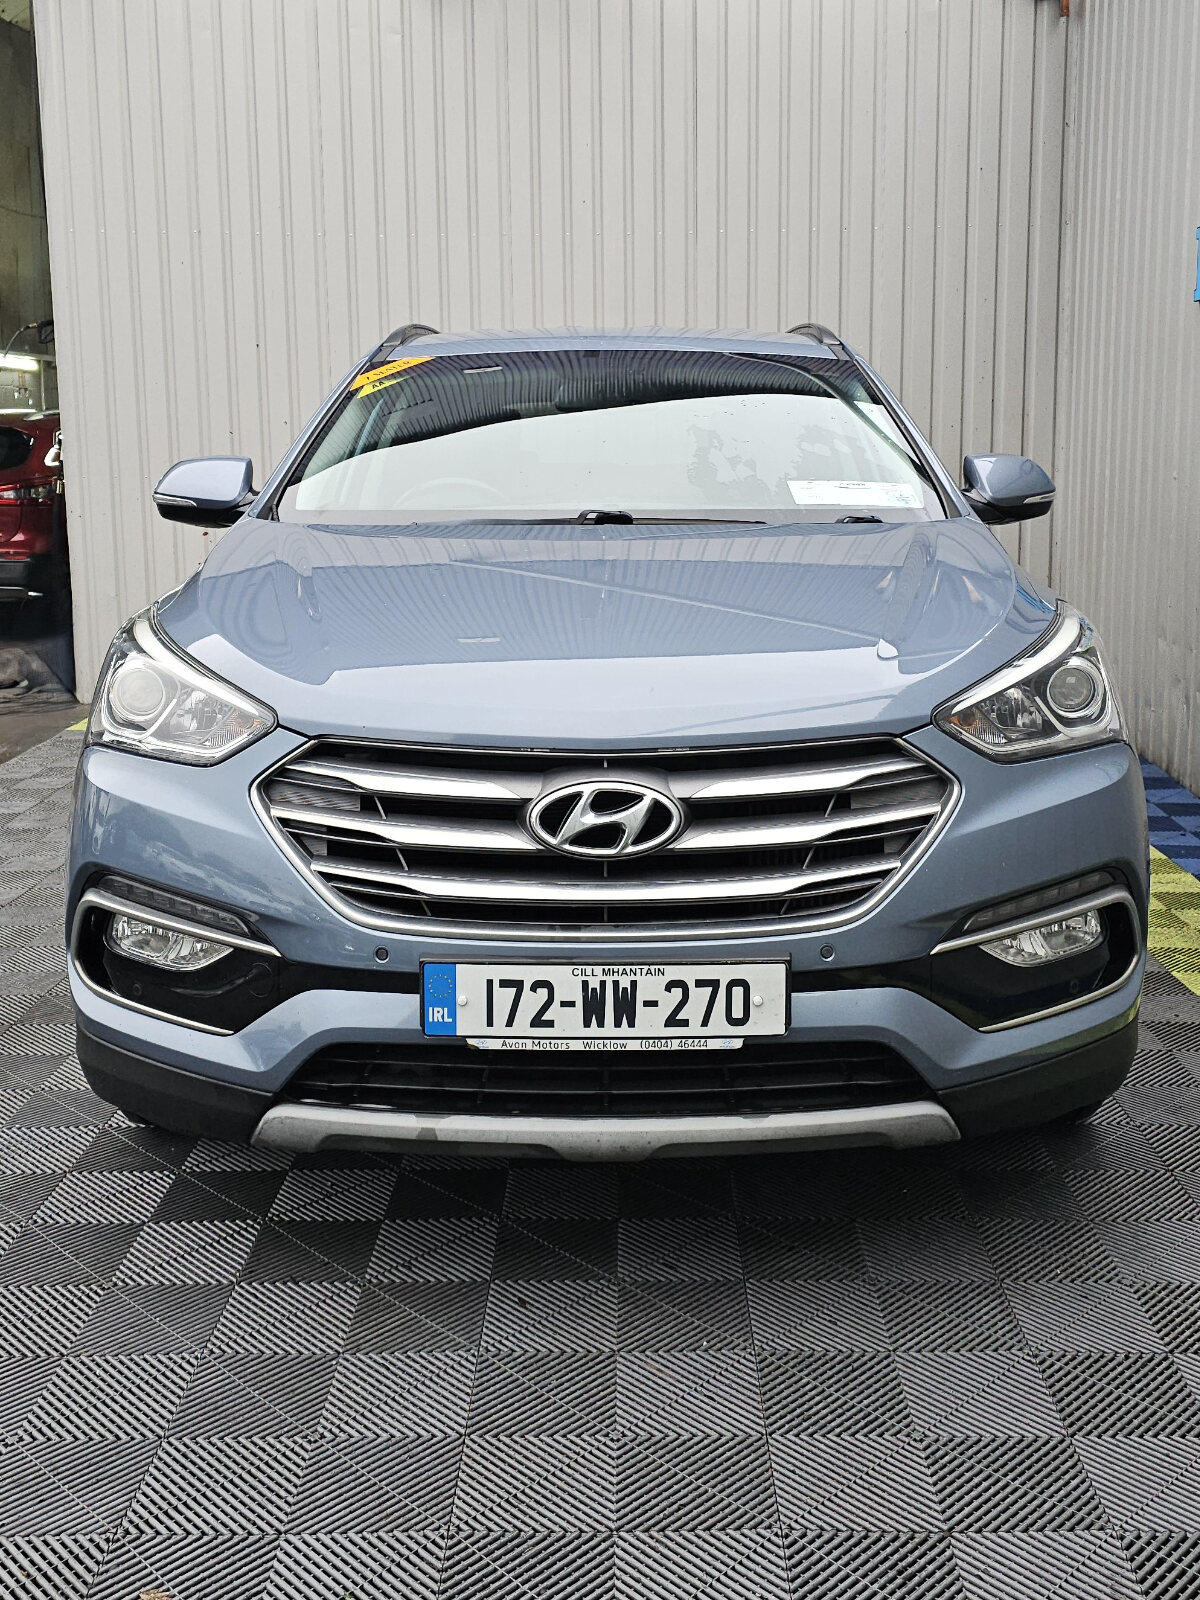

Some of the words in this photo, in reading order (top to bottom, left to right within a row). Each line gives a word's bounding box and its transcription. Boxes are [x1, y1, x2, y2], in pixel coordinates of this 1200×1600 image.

[571, 967, 599, 977] CILL
[486, 978, 751, 1028] 172-WW-270
[428, 1006, 453, 1022] IRL
[500, 1039, 527, 1049] Avon
[531, 1039, 571, 1049] Motors
[582, 1040, 628, 1050] Wicklow
[639, 1039, 673, 1050] (0404)
[677, 1039, 708, 1049] 46444
